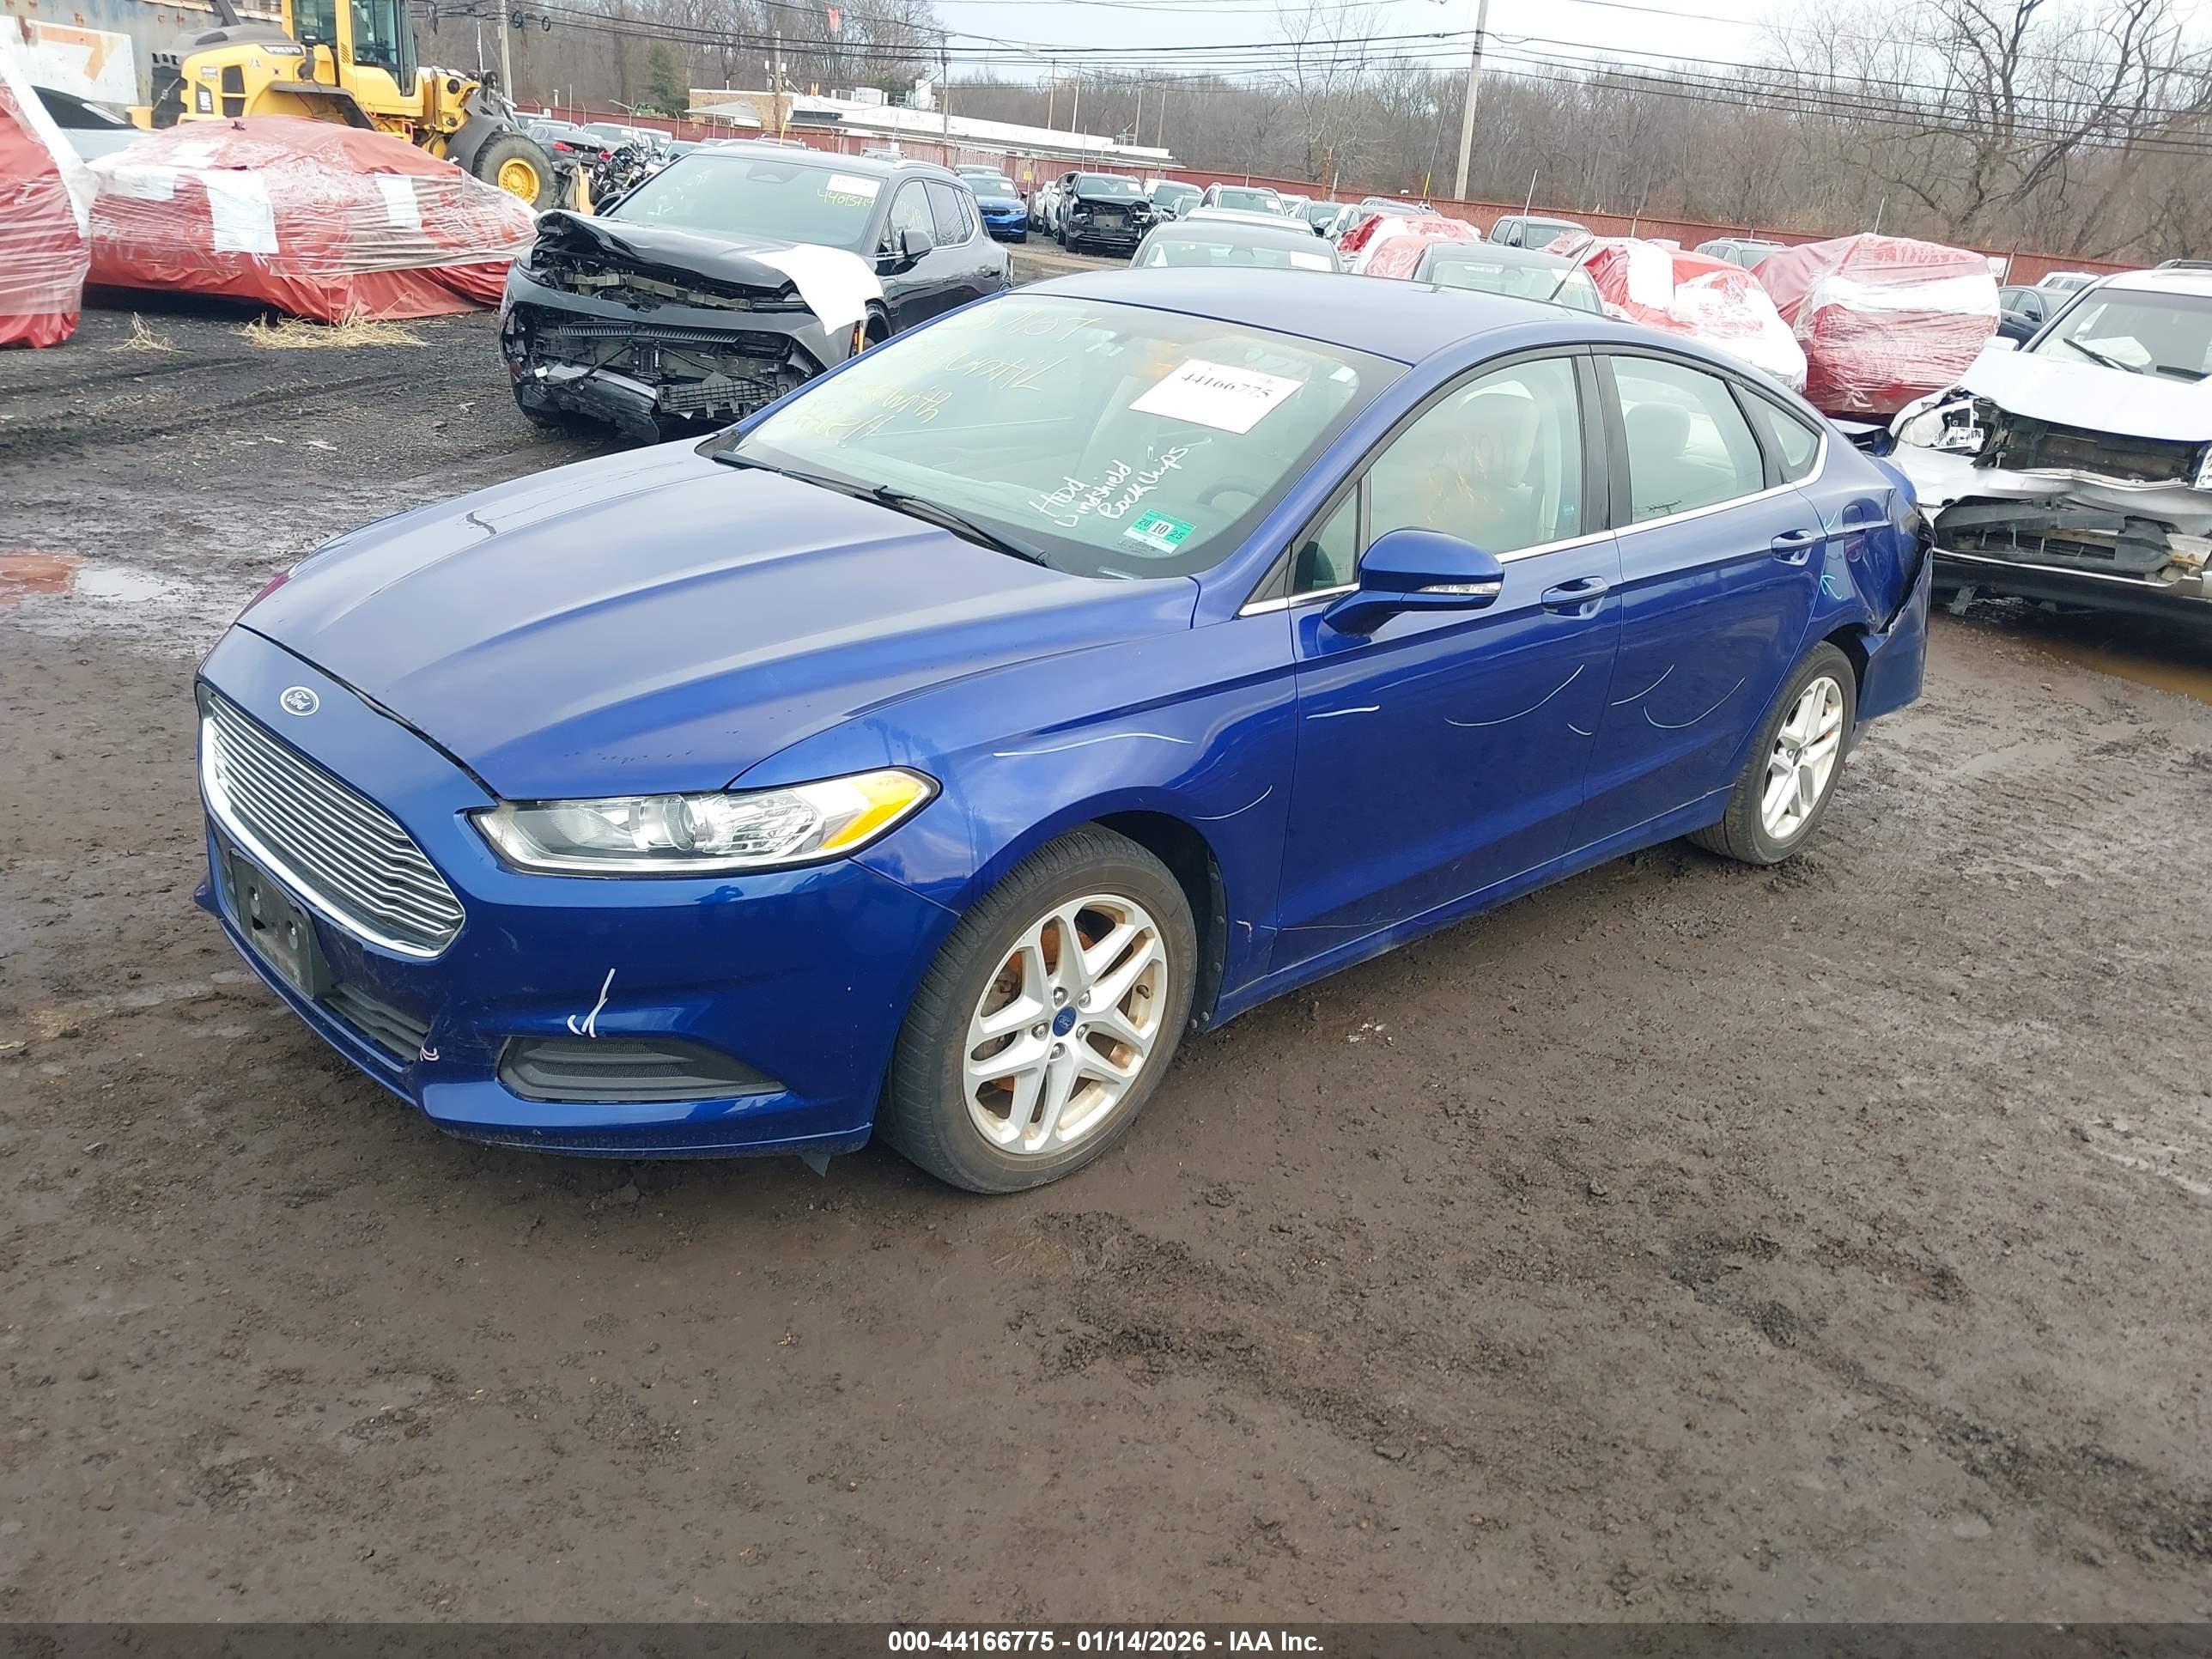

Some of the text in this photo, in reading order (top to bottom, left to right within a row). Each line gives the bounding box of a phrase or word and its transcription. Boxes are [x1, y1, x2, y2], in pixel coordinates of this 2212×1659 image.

[264, 46, 301, 54] VOLVO
[1139, 517, 1152, 527] 20
[1152, 522, 1170, 535] 10
[1170, 530, 1185, 540] 25
